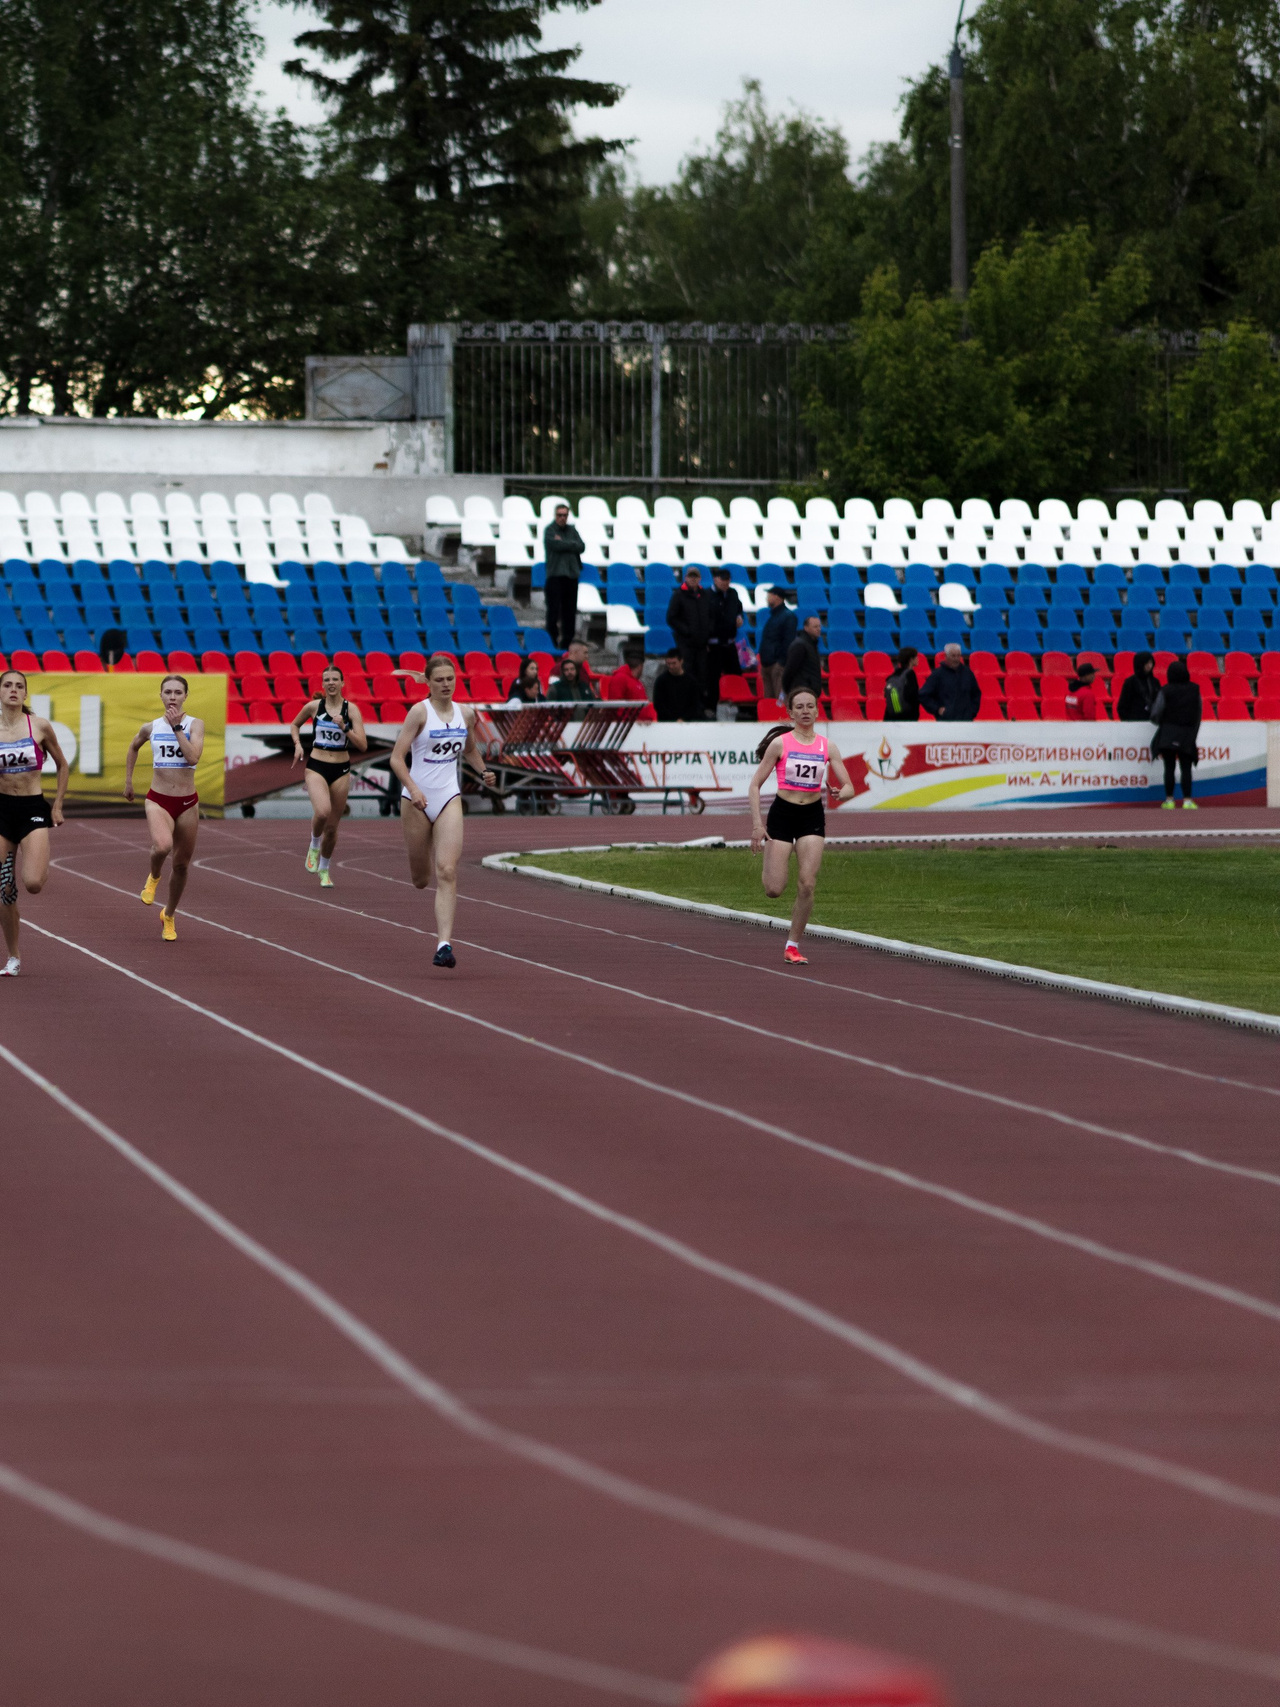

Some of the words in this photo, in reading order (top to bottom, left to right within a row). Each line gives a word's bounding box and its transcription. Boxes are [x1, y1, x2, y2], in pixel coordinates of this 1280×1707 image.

[320, 730, 341, 742] 130
[159, 744, 185, 758] 136
[431, 741, 462, 755] 490
[926, 746, 985, 765] ЦЕНТР
[988, 744, 1108, 763] СПОРТИВНОЙ
[1114, 746, 1230, 763] ПОДВКИ
[0, 752, 29, 767] 124
[795, 763, 818, 779] 121
[1007, 775, 1035, 786] им.
[1039, 772, 1056, 786] А.
[1061, 772, 1149, 787] Игнатьева
